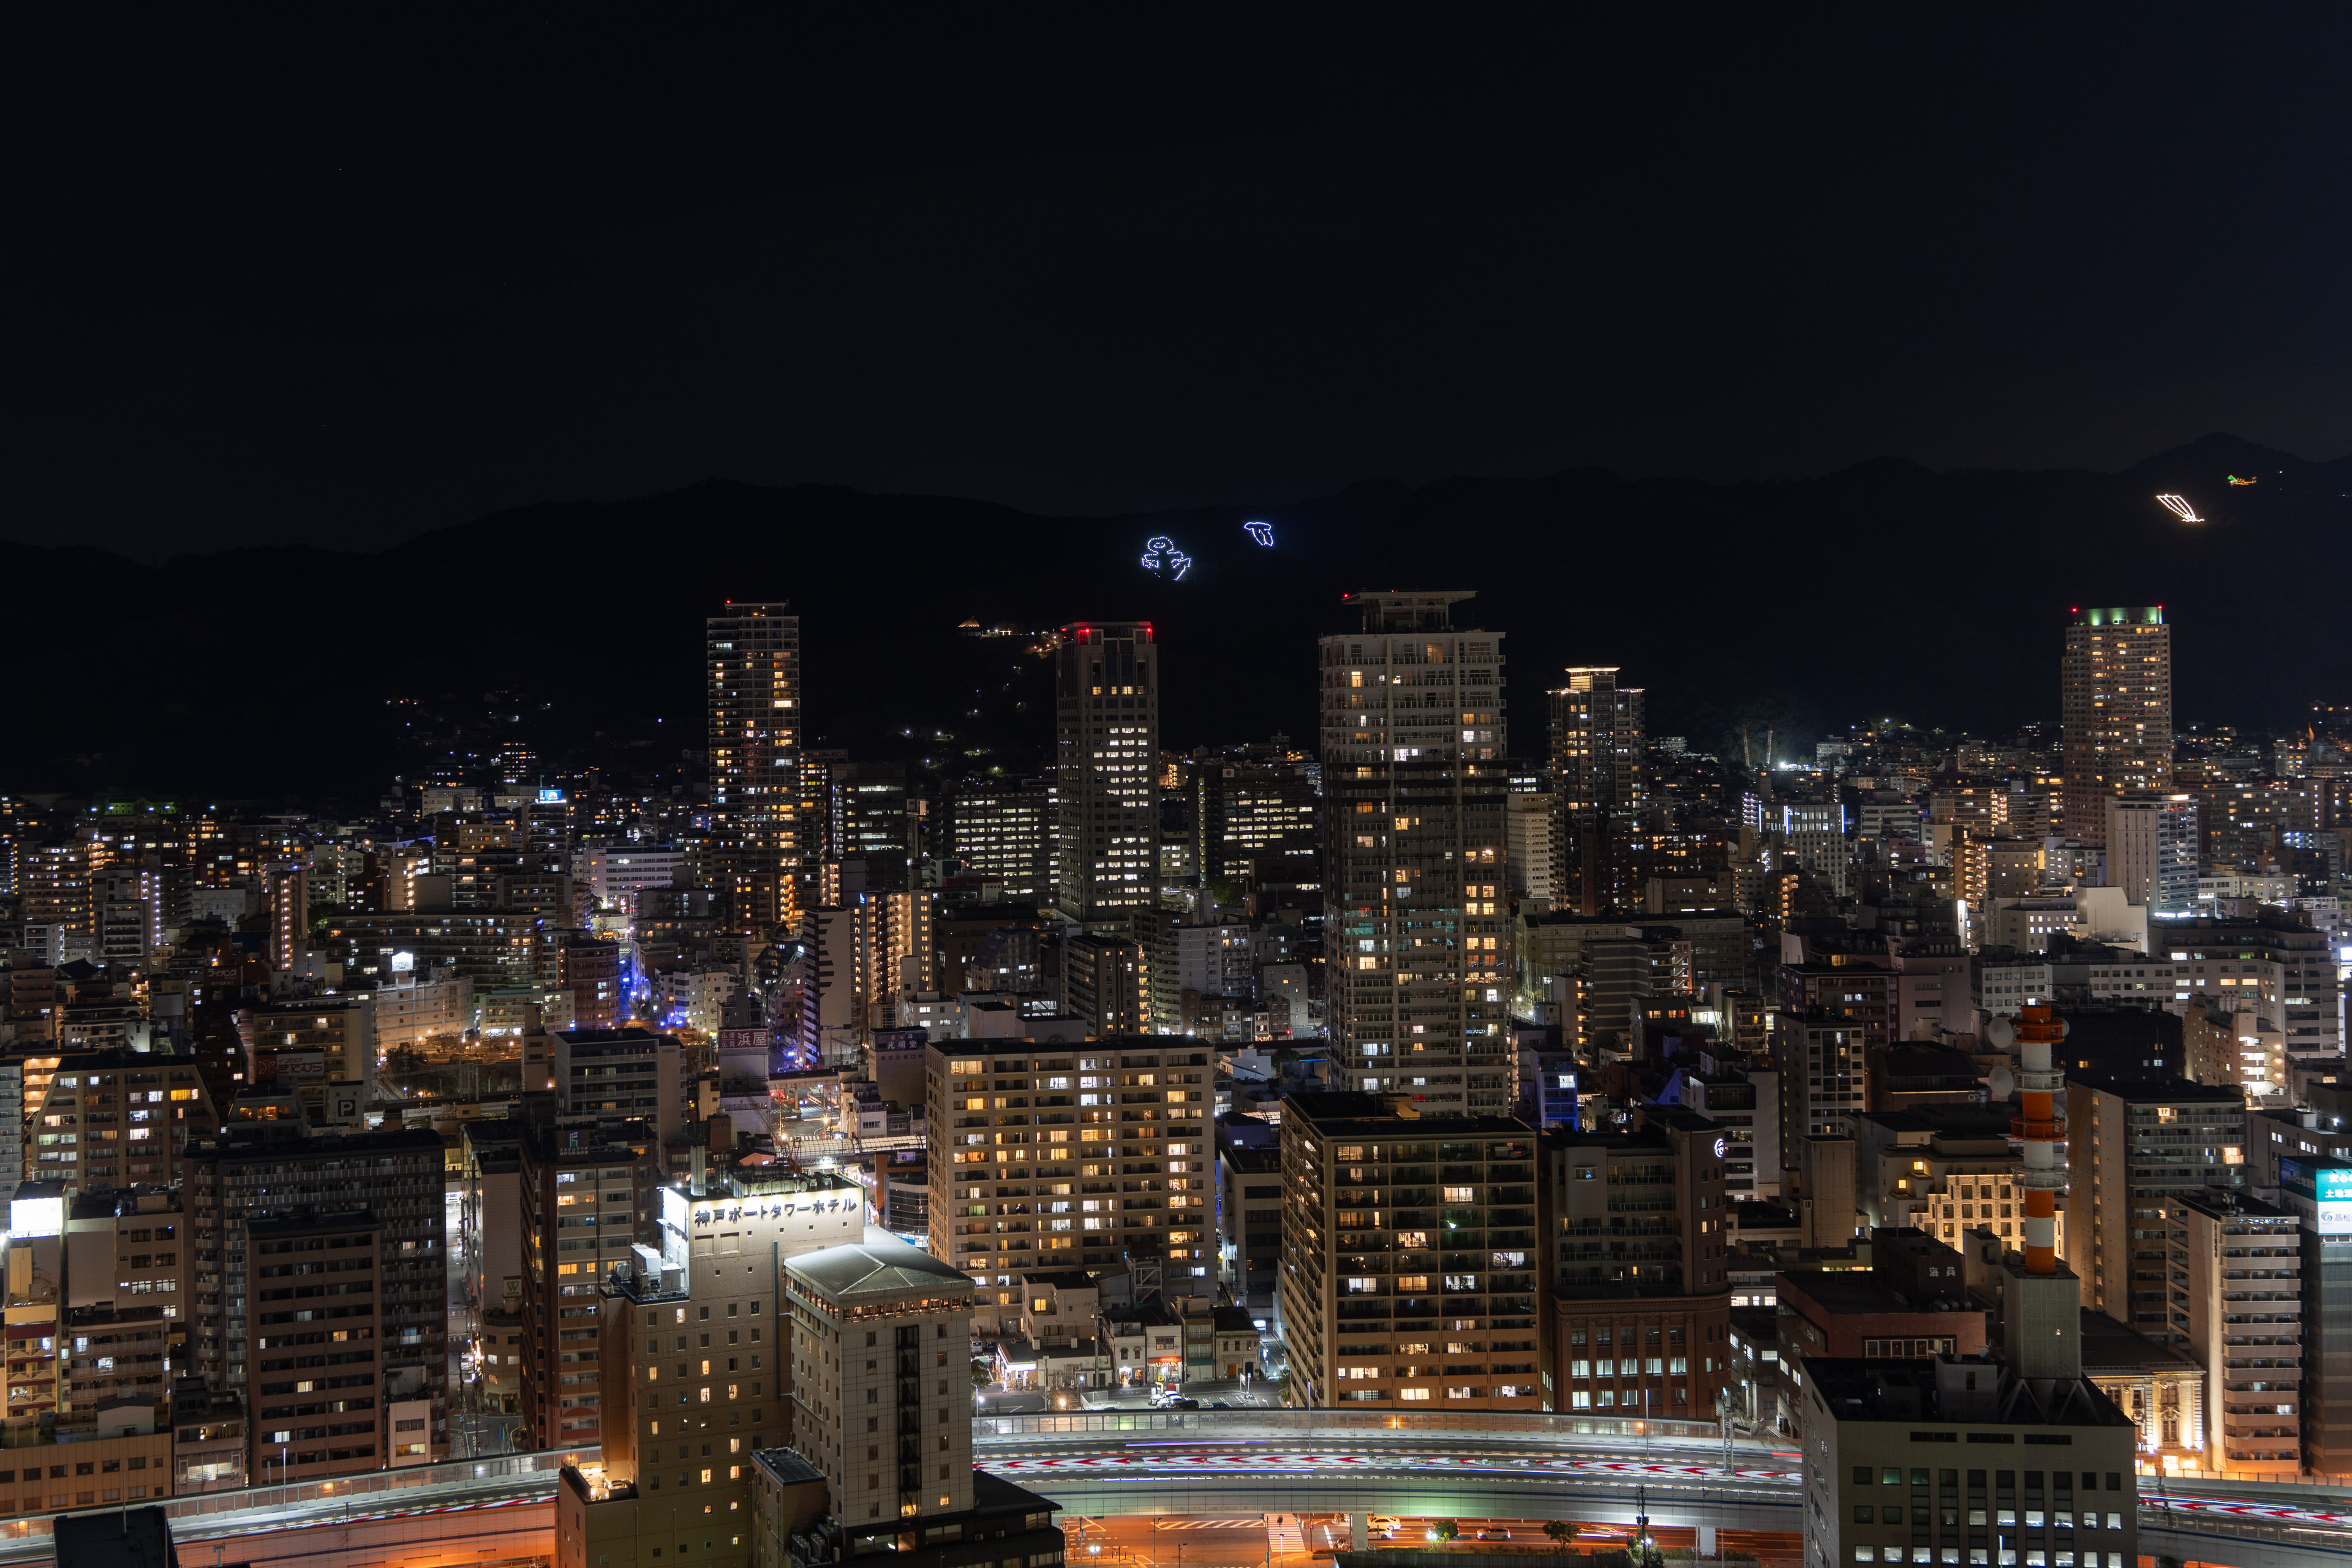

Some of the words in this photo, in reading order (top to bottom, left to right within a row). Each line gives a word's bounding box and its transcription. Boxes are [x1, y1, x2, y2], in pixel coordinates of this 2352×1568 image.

[207, 968, 238, 978] ライオンズ
[737, 1031, 767, 1046] 浜屋
[887, 1040, 917, 1049] 光明堂
[277, 1061, 323, 1074] きたむら
[340, 1101, 353, 1117] P
[695, 1198, 857, 1227] 神戸ポートタワーホテル
